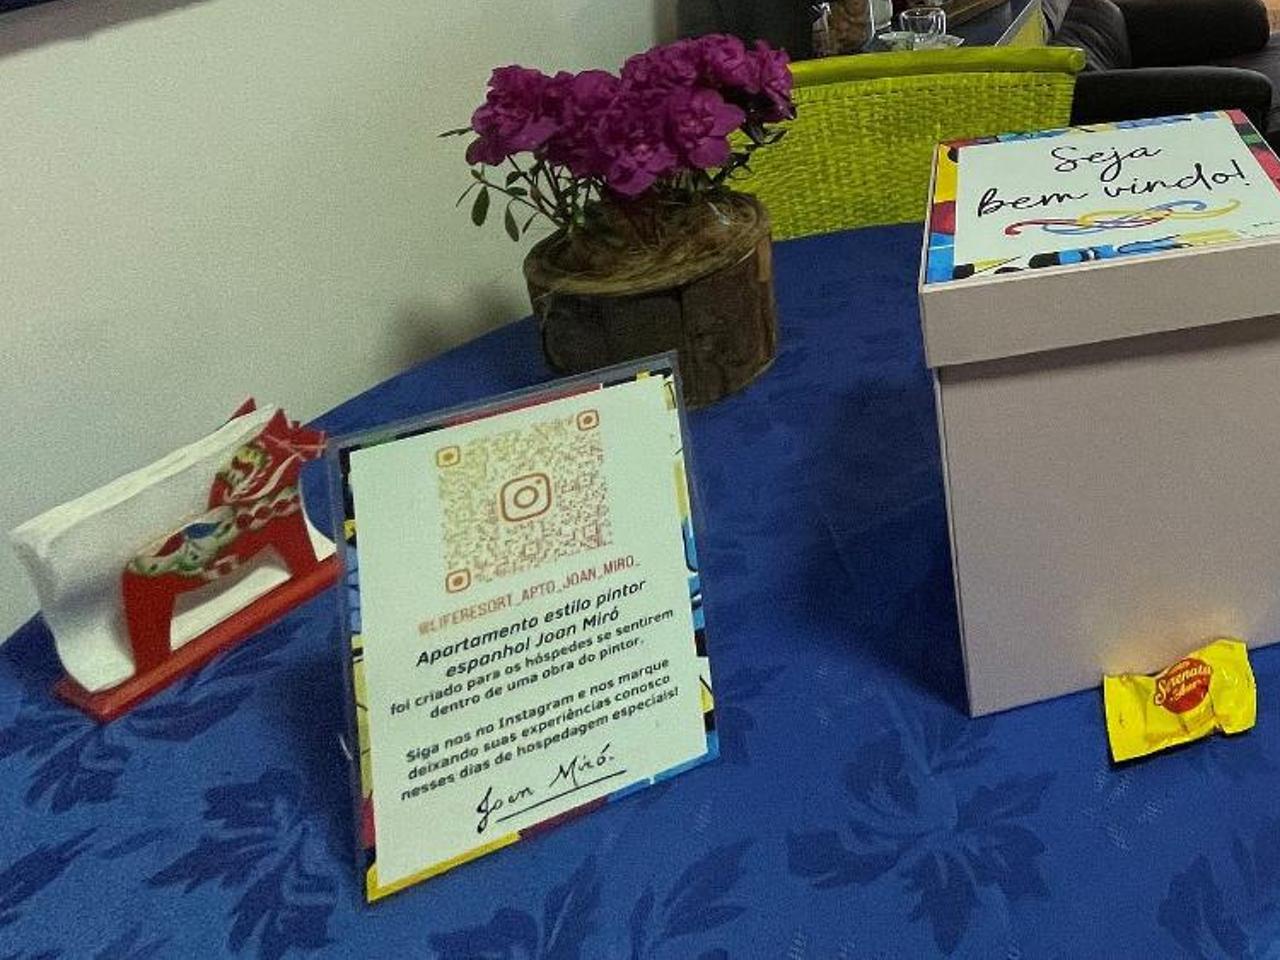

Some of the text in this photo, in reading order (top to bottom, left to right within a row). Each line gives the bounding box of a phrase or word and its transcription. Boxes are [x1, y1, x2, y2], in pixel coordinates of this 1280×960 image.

[1051, 146, 1161, 182] Seja
[1103, 159, 1250, 197] vindo!
[390, 608, 674, 716] foi criado para os hóspedes se sentirem
[416, 580, 646, 667] Apartamento estilo pintor
[446, 606, 620, 677] espanhol Joan Miró
[406, 658, 670, 763] Siga nos no Instagram e nos marque
[430, 636, 645, 719] dentro de uma obra do pintor.
[400, 686, 679, 801] nesses dias de hospedagem especiais!
[408, 675, 671, 781] deixando suas experiências conosco
[476, 786, 535, 834] Joan
